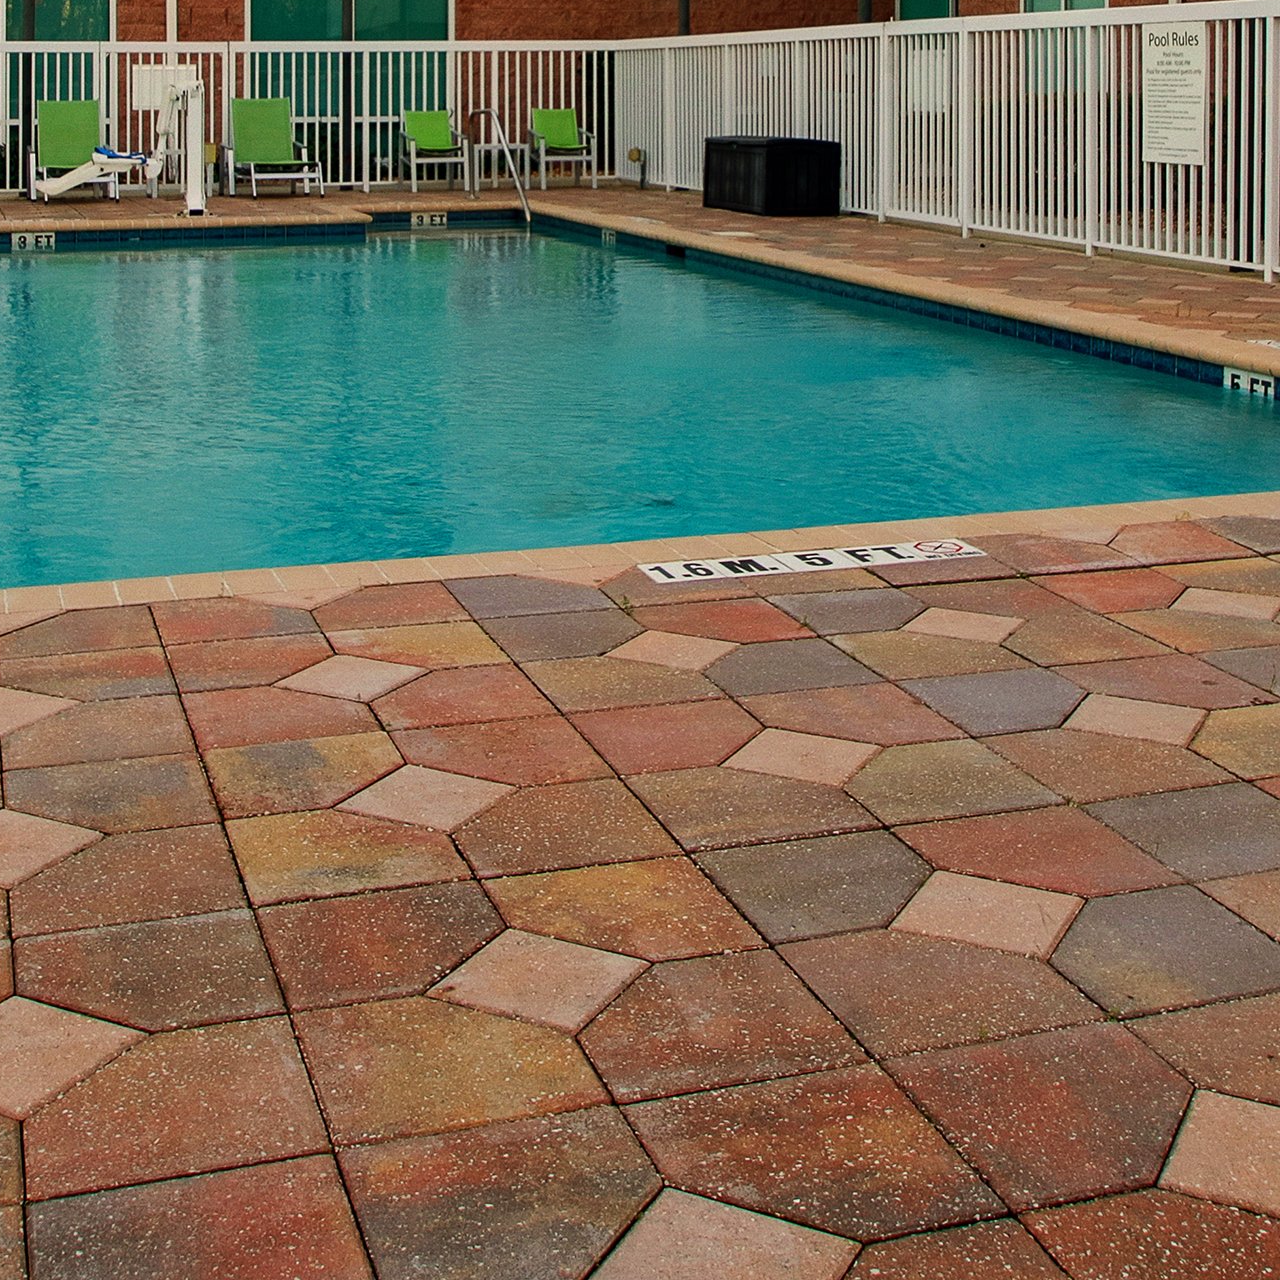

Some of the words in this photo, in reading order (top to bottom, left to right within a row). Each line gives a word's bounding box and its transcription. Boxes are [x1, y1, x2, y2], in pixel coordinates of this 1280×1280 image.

[1148, 32, 1170, 47] Pool
[1171, 31, 1199, 47] Rules
[649, 562, 714, 580] 1.6
[719, 558, 779, 574] M.
[794, 552, 833, 567] 5
[843, 546, 914, 563] FT.
